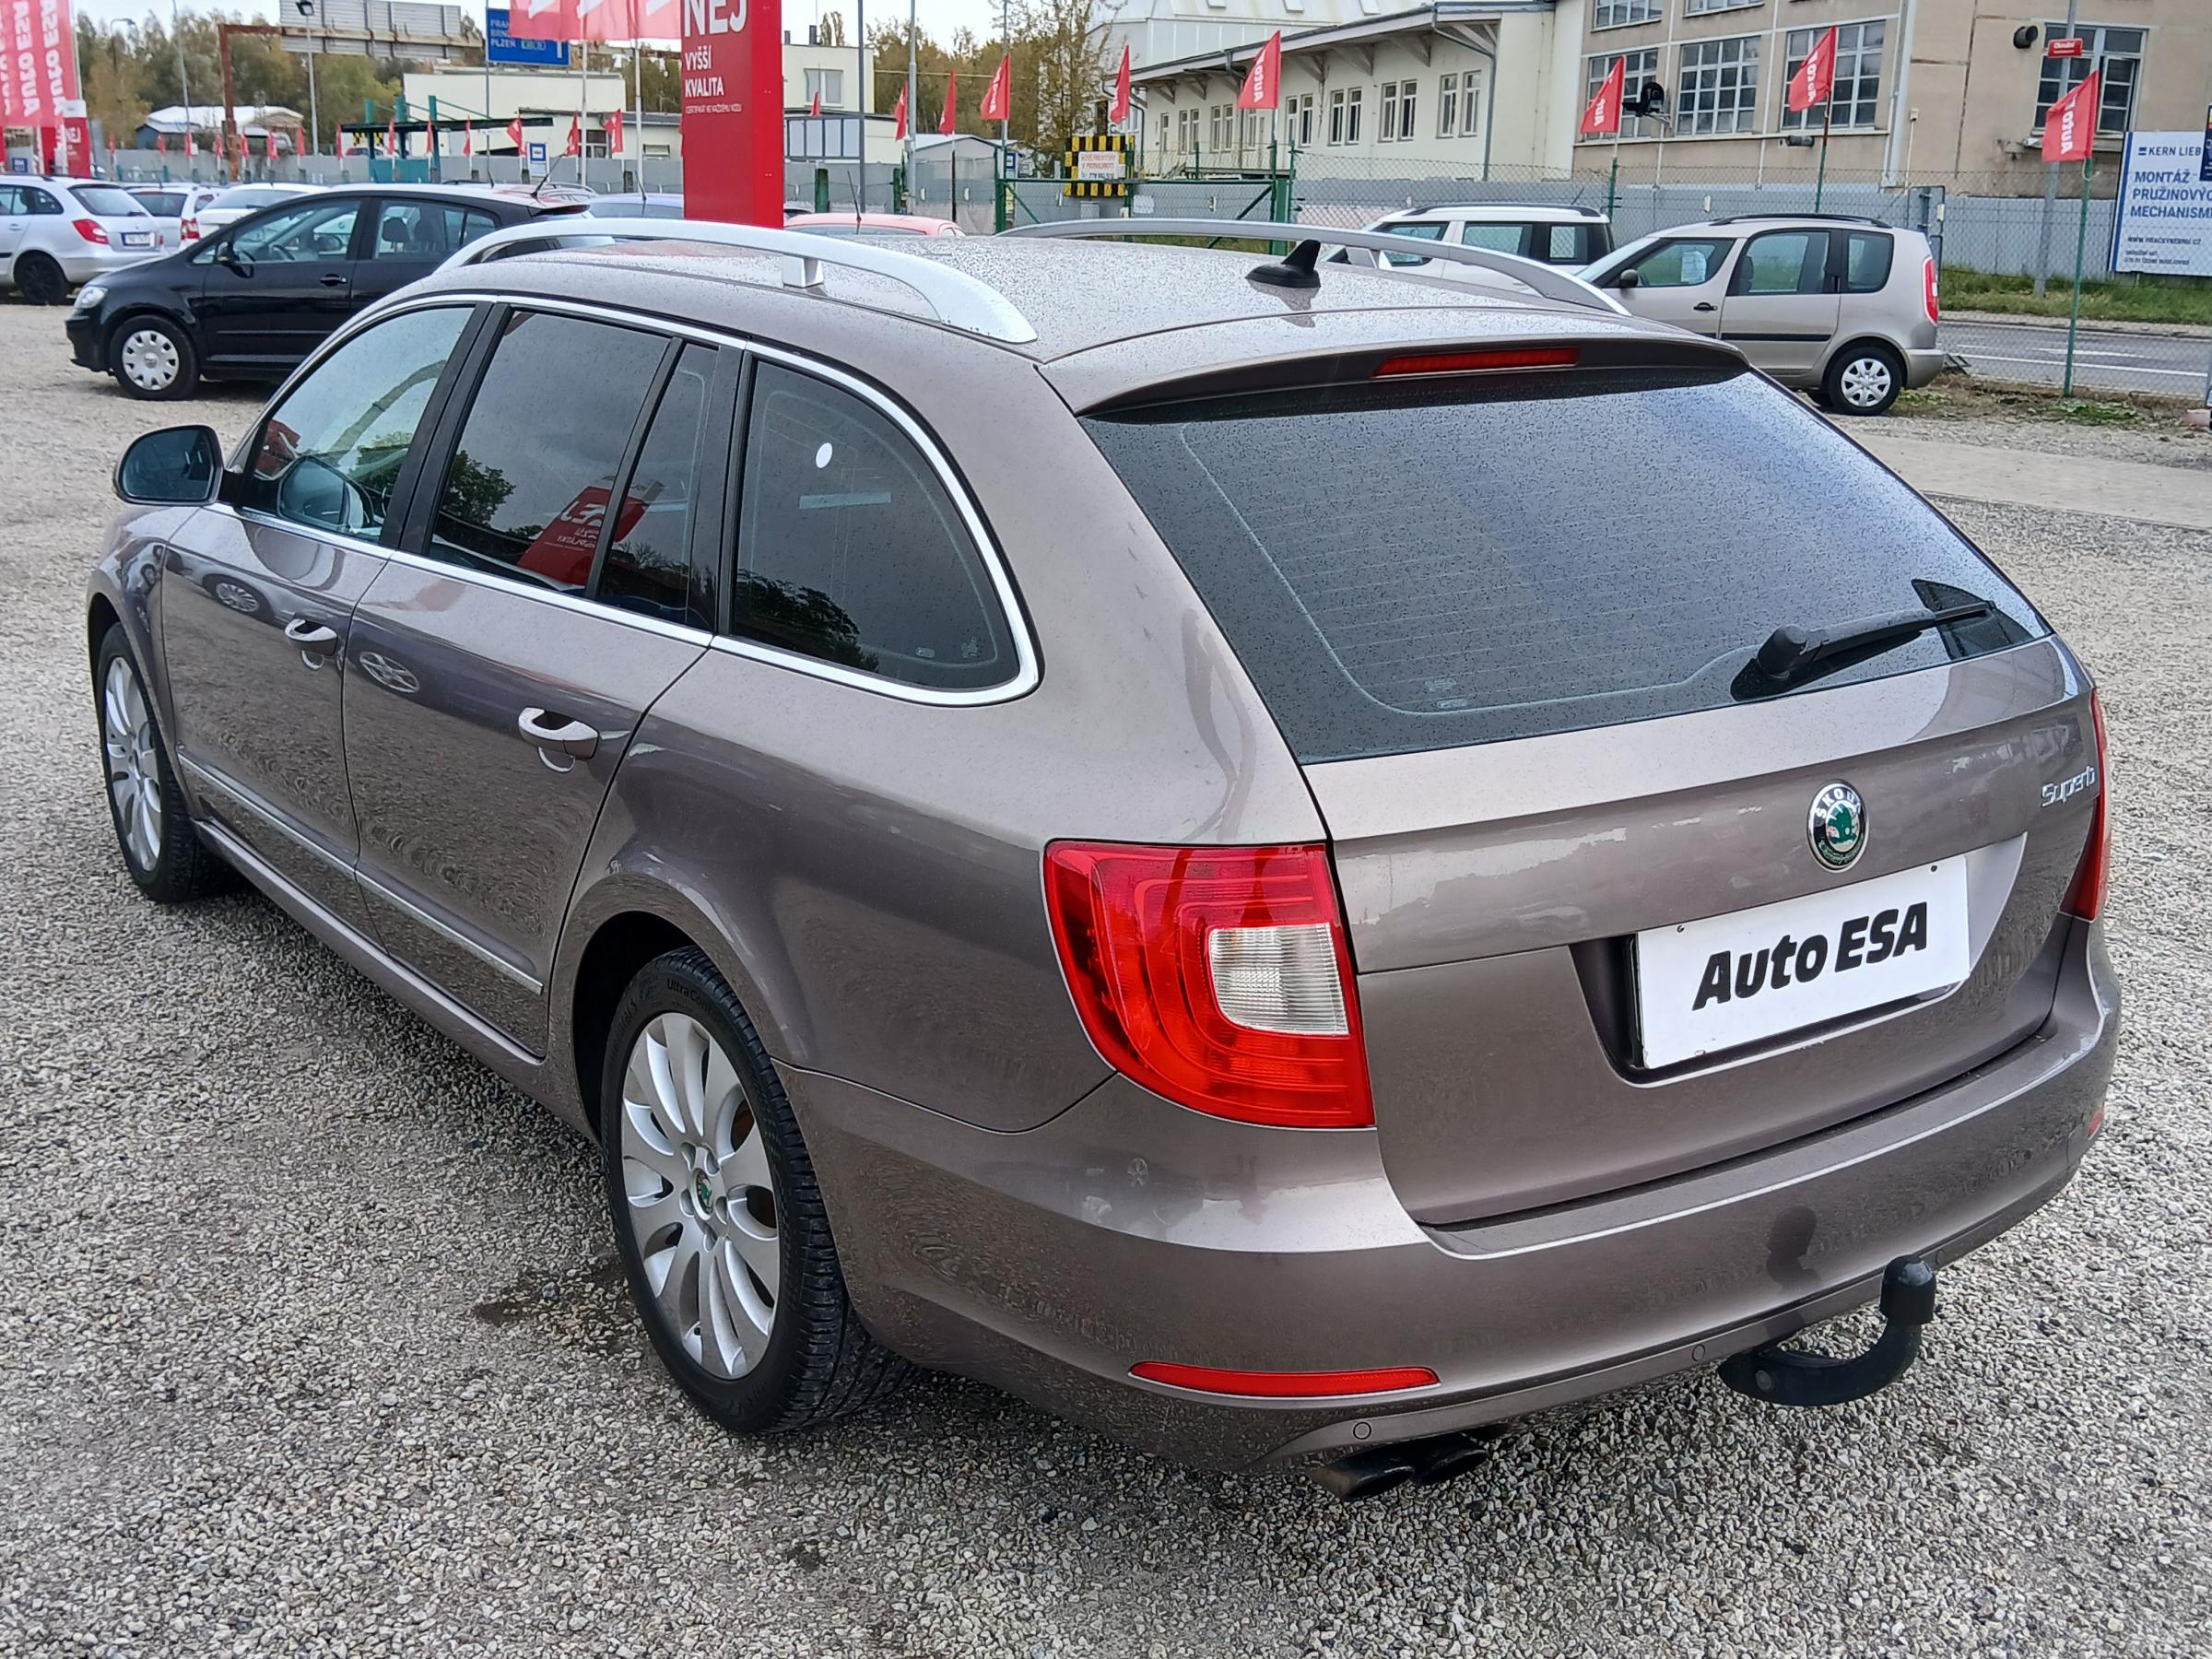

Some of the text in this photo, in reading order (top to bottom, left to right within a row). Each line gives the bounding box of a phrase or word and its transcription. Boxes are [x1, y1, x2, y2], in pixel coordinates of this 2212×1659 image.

[684, 0, 747, 37] NEJ
[685, 44, 712, 71] VYŠŠÍ
[685, 76, 724, 98] KVALITA
[2148, 147, 2176, 156] KERN
[2135, 169, 2191, 183] MONTÁŽ
[2130, 206, 2212, 218] MECHANISM
[2041, 766, 2095, 806] Superb
[1692, 901, 1927, 1010] Auto ESA
